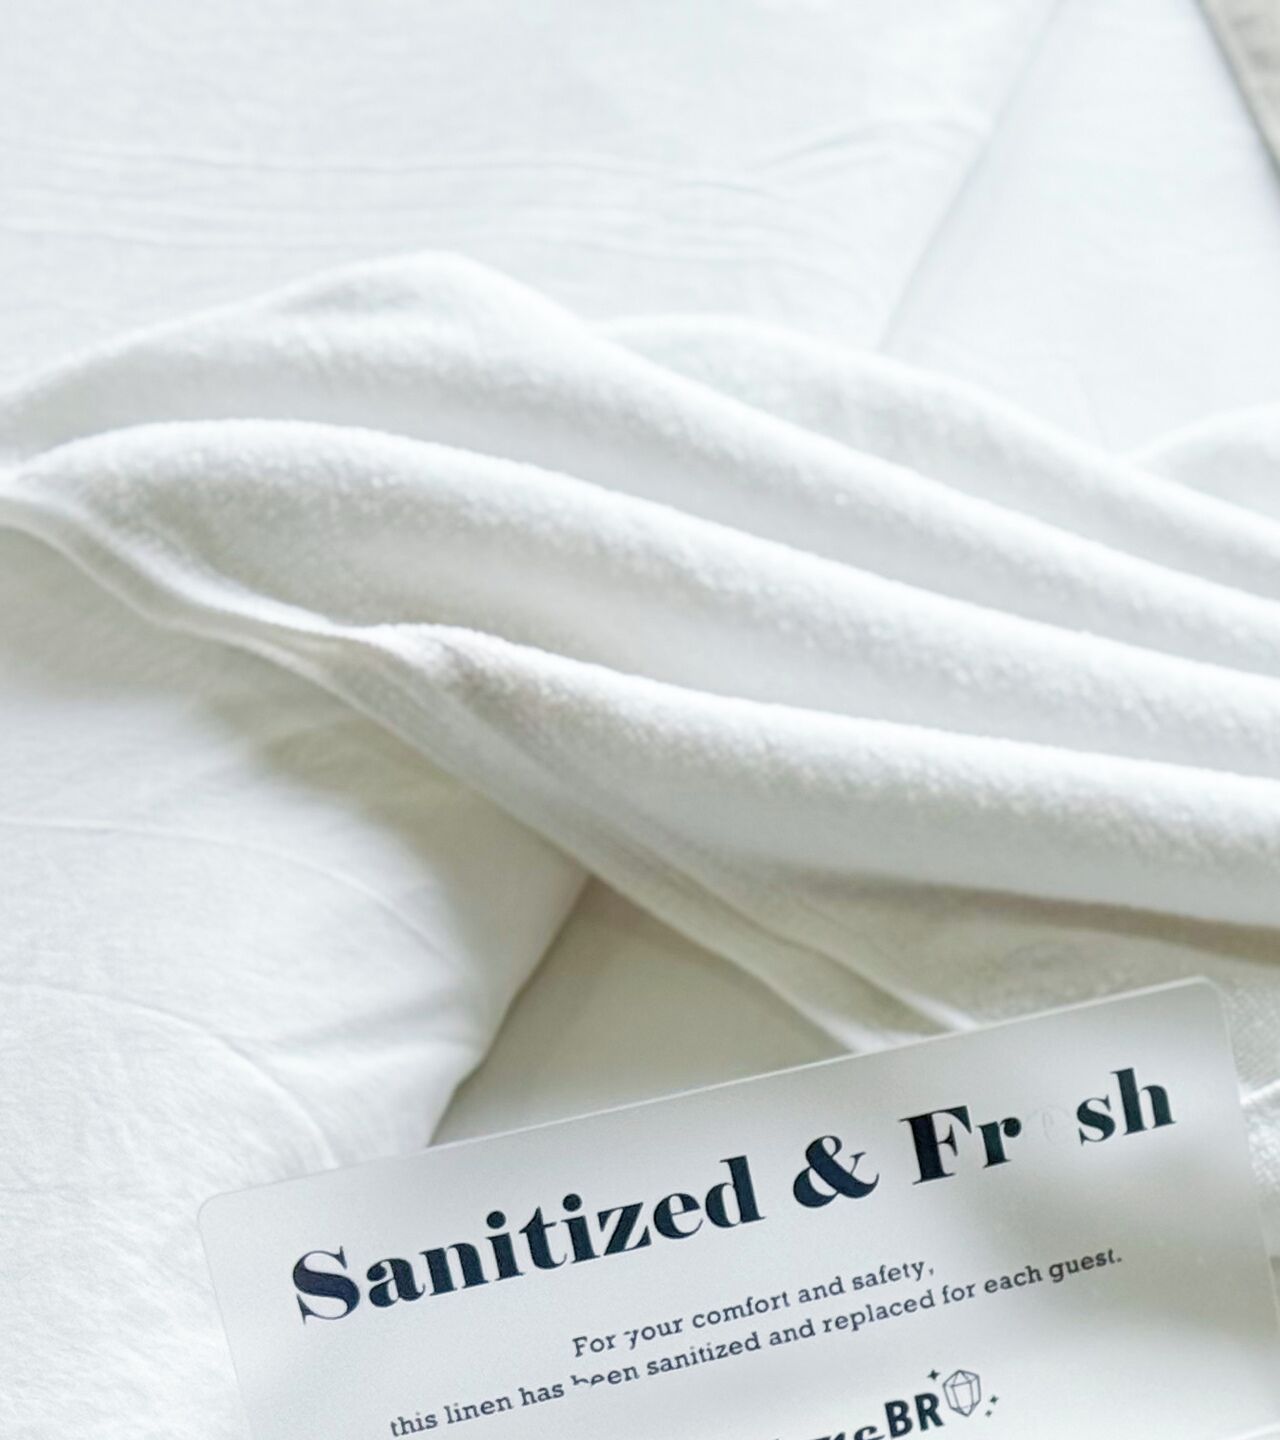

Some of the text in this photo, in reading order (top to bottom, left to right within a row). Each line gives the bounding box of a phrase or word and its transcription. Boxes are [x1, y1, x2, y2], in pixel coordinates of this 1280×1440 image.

[291, 1067, 1176, 1324] Sanitized & Frsh
[390, 1412, 439, 1438] this
[443, 1396, 514, 1425] linen
[517, 1383, 565, 1407] has
[646, 1330, 762, 1376] sanitized
[769, 1318, 816, 1346] and
[821, 1288, 936, 1333] replaced
[941, 1283, 976, 1305] for
[983, 1265, 1044, 1294] each
[1048, 1248, 1122, 1284] guest.
[571, 1261, 934, 1358] For your comfort and safety,
